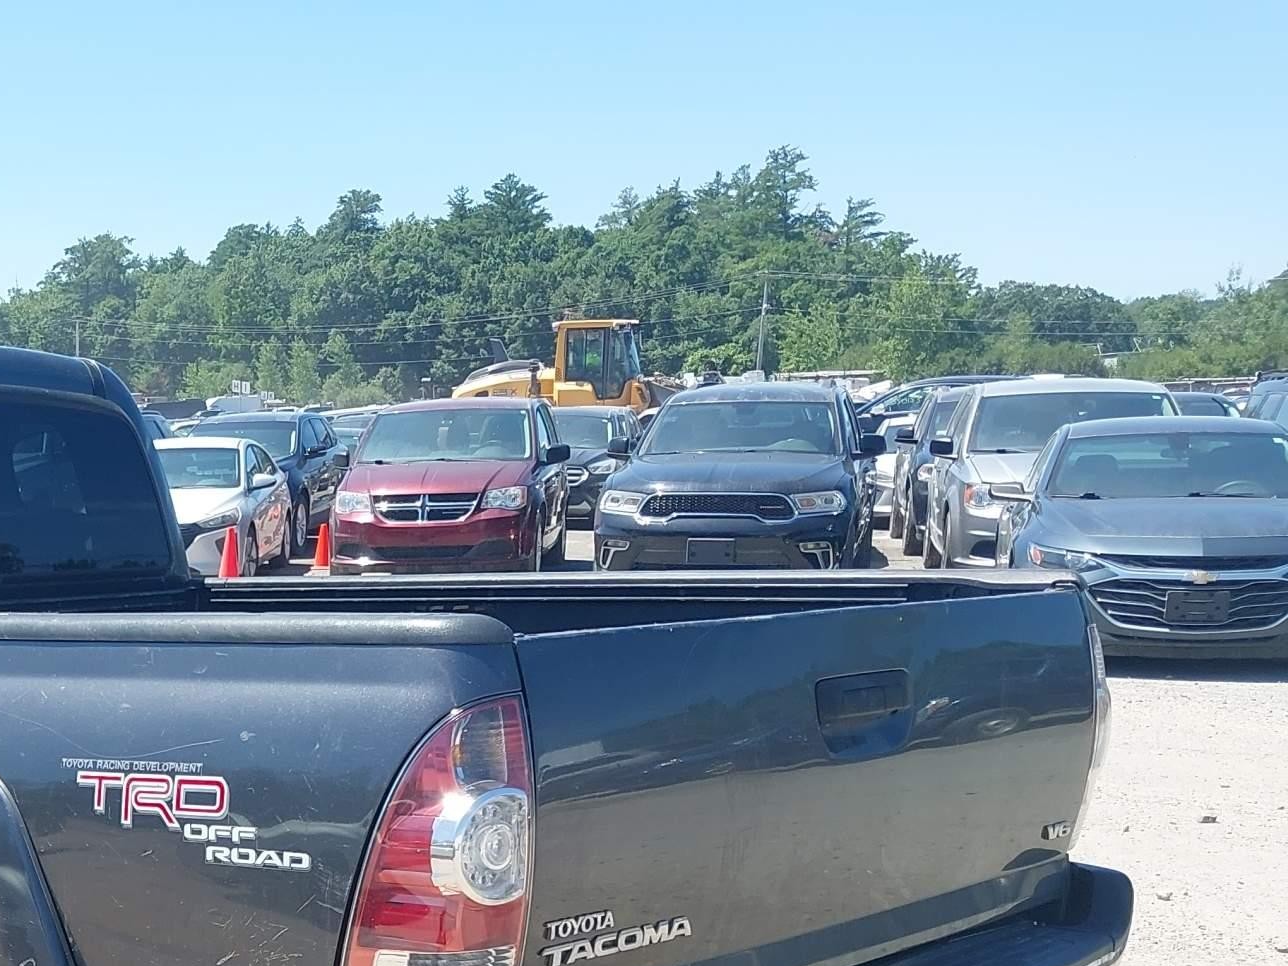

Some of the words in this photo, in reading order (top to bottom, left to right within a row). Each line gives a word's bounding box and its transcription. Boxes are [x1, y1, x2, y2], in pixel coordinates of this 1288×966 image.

[62, 758, 94, 769] TOYOTA
[96, 760, 130, 771] RACING
[132, 762, 203, 773] DEVELOPMENT
[76, 770, 230, 832] TRD
[183, 823, 258, 844] OFF
[1043, 820, 1071, 840] V6
[205, 845, 312, 872] ROAD
[545, 910, 615, 941] TOYOTA
